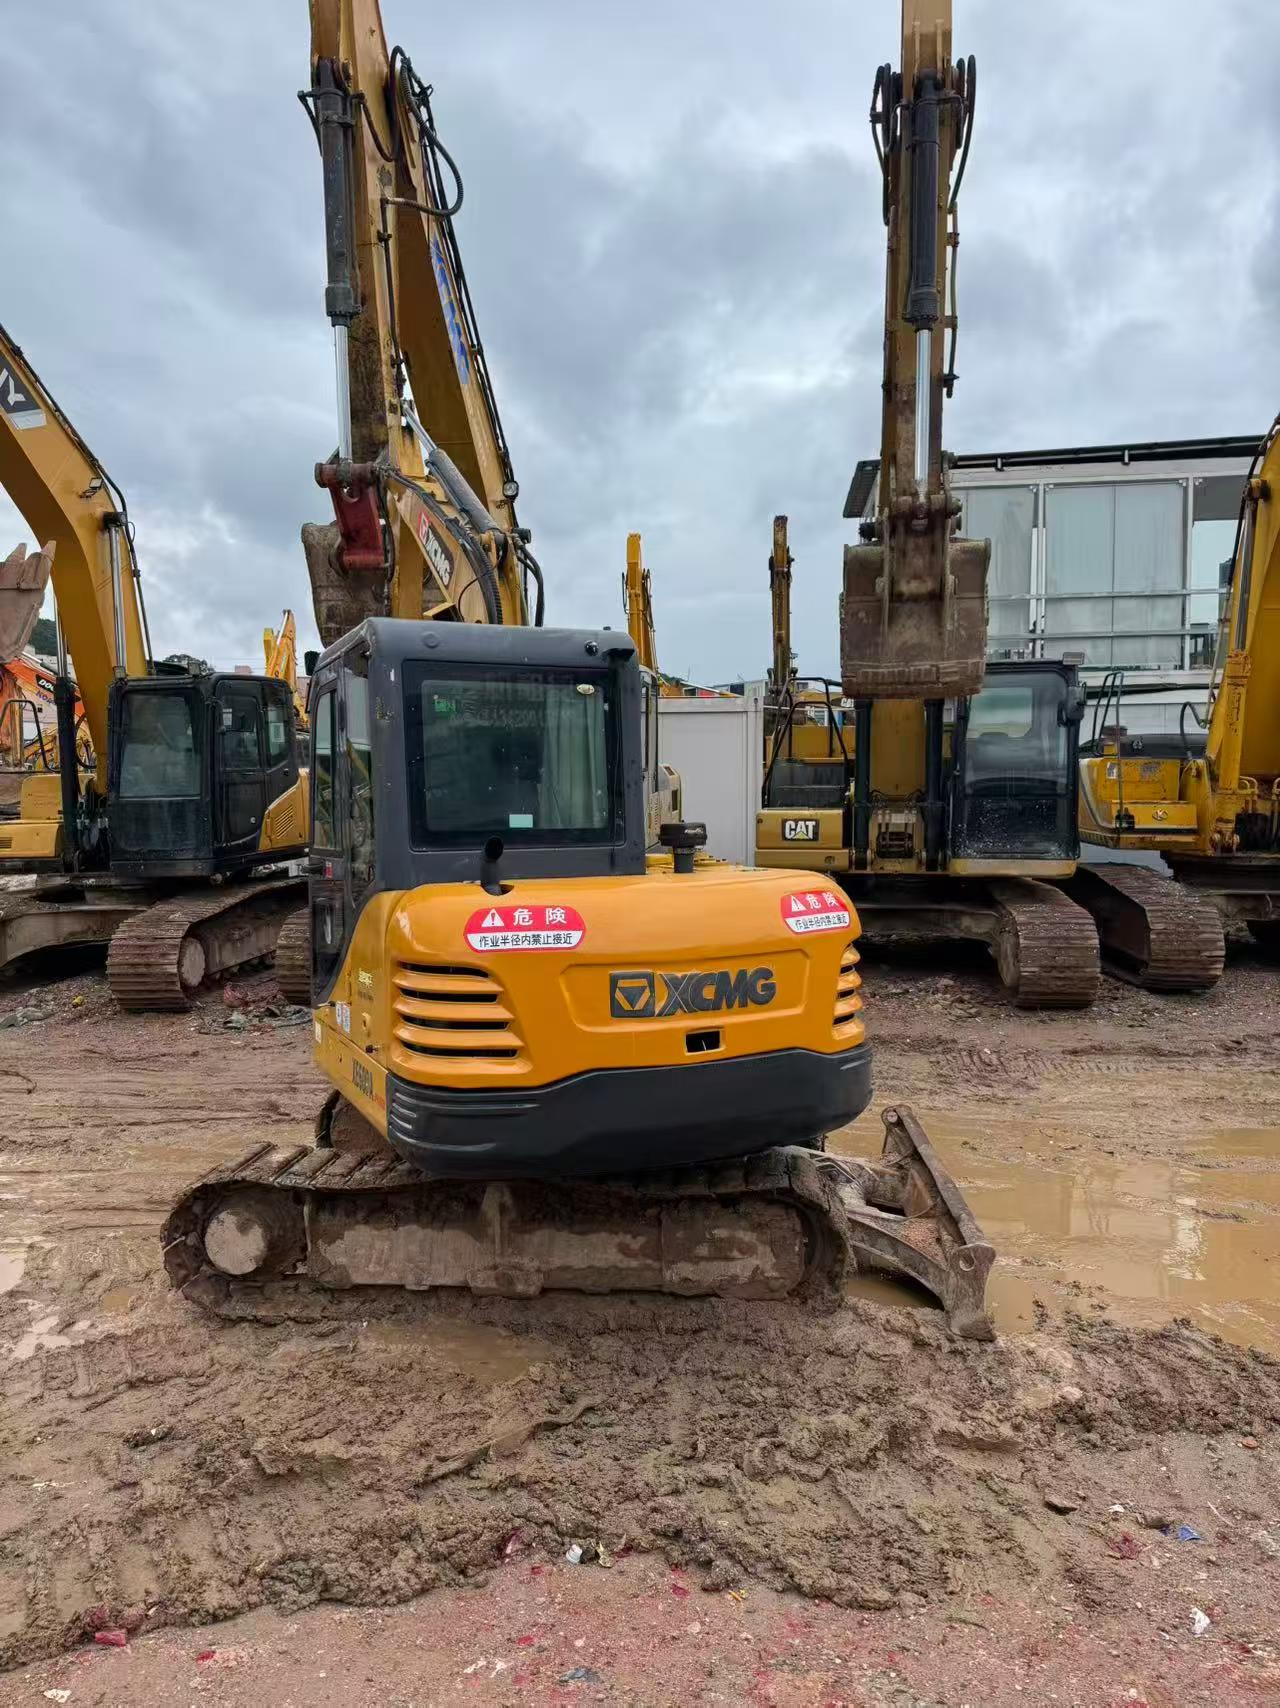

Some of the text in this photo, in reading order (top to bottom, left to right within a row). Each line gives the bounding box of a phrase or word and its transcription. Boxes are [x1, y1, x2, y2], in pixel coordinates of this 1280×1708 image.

[785, 820, 816, 840] CAT
[479, 932, 573, 948] 作业半径内禁止接近
[655, 967, 777, 1017] XCMG
